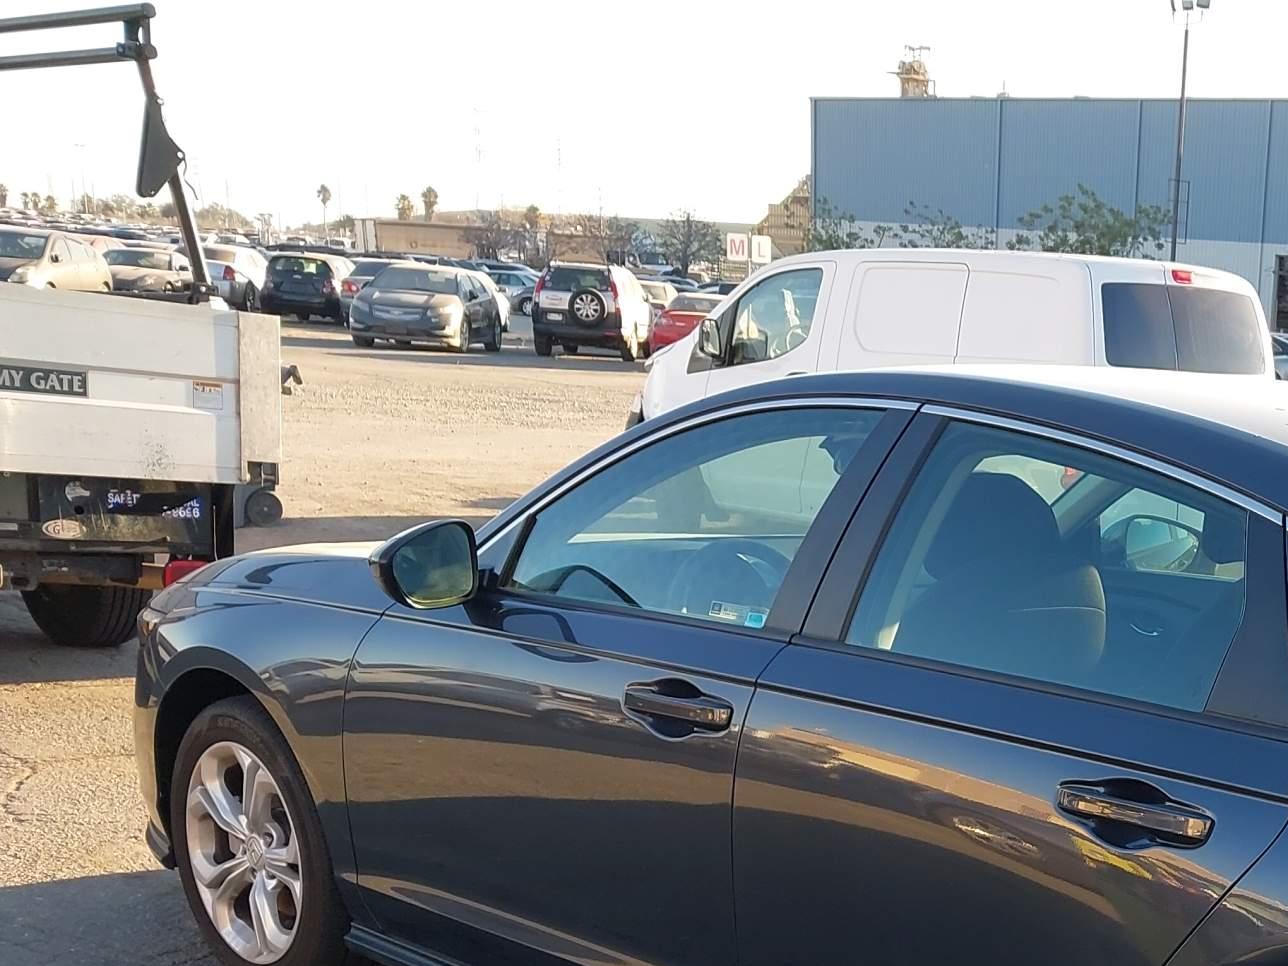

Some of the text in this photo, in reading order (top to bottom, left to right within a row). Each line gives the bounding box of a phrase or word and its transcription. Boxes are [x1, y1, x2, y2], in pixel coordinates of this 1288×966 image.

[730, 239, 745, 257] M
[758, 241, 768, 258] L
[30, 371, 84, 393] GATE
